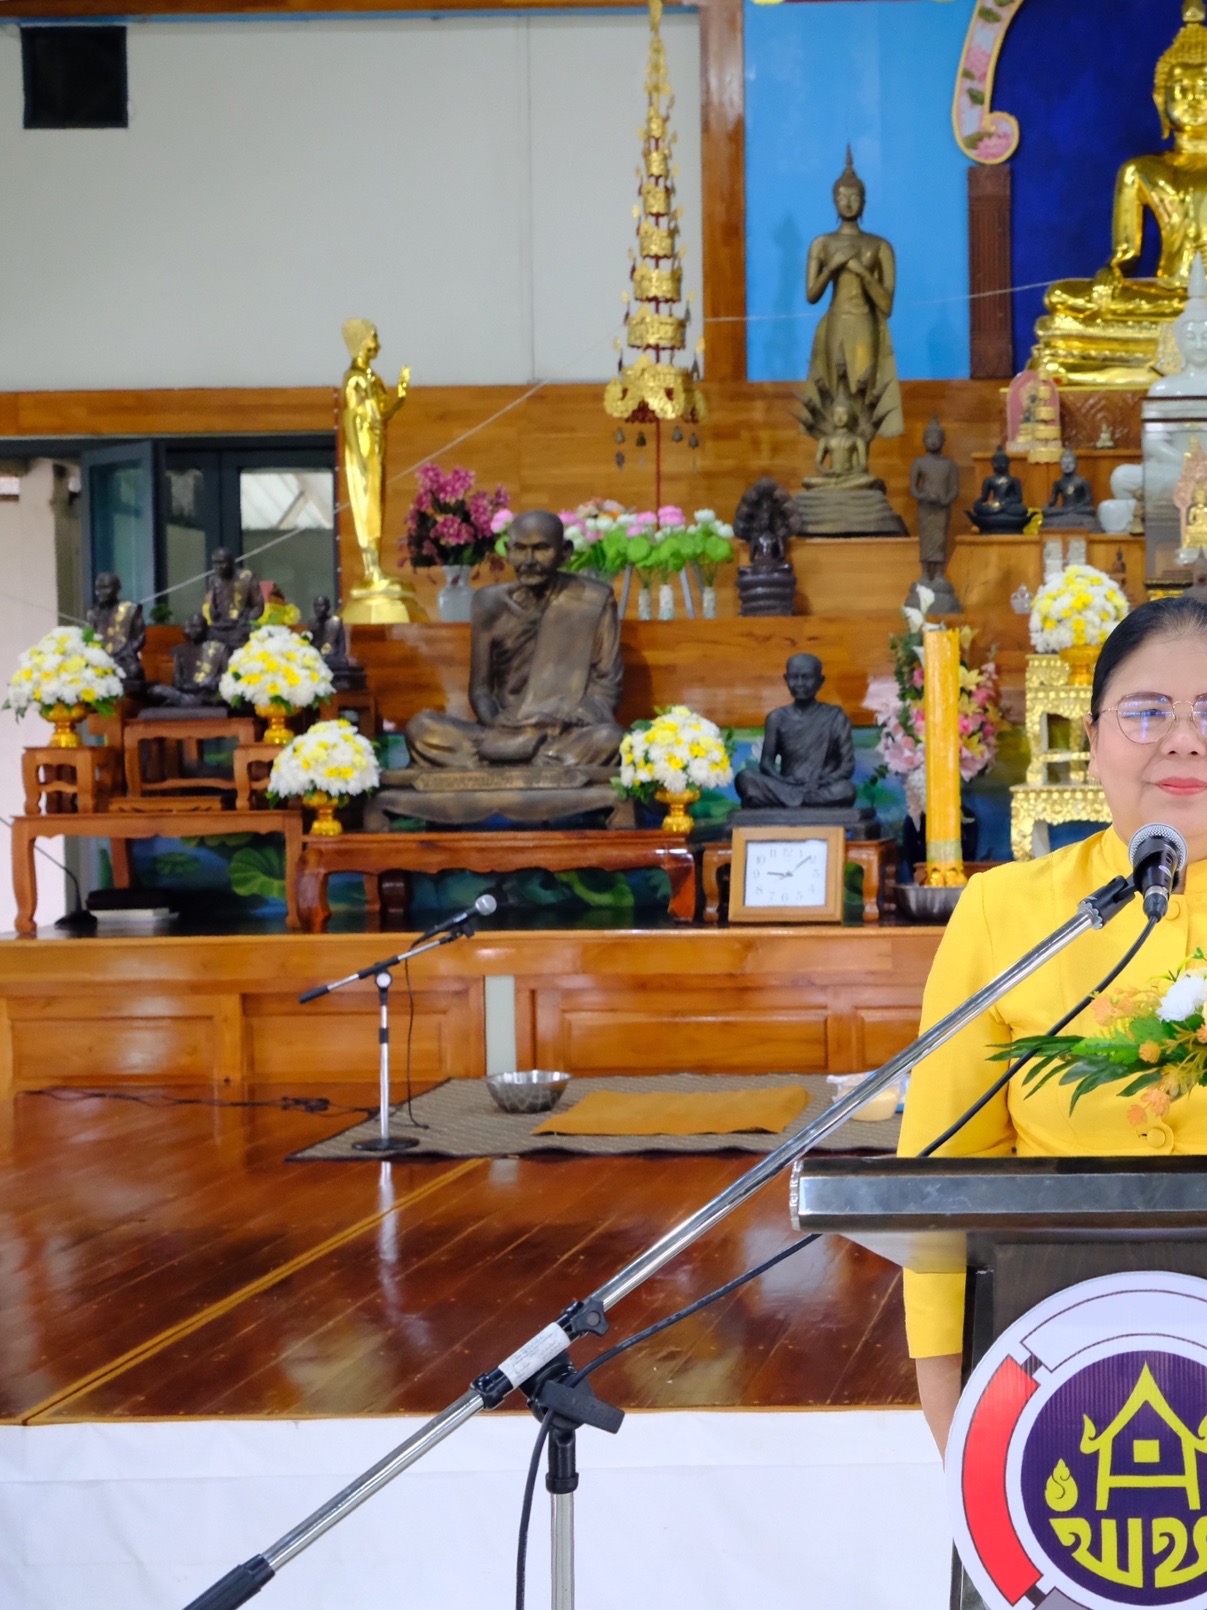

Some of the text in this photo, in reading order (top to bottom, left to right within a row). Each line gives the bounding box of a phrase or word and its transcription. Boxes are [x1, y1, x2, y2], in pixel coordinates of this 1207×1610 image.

[769, 848, 777, 858] 11
[756, 855, 766, 865] 10
[753, 869, 760, 880] 9
[781, 891, 789, 902] 6
